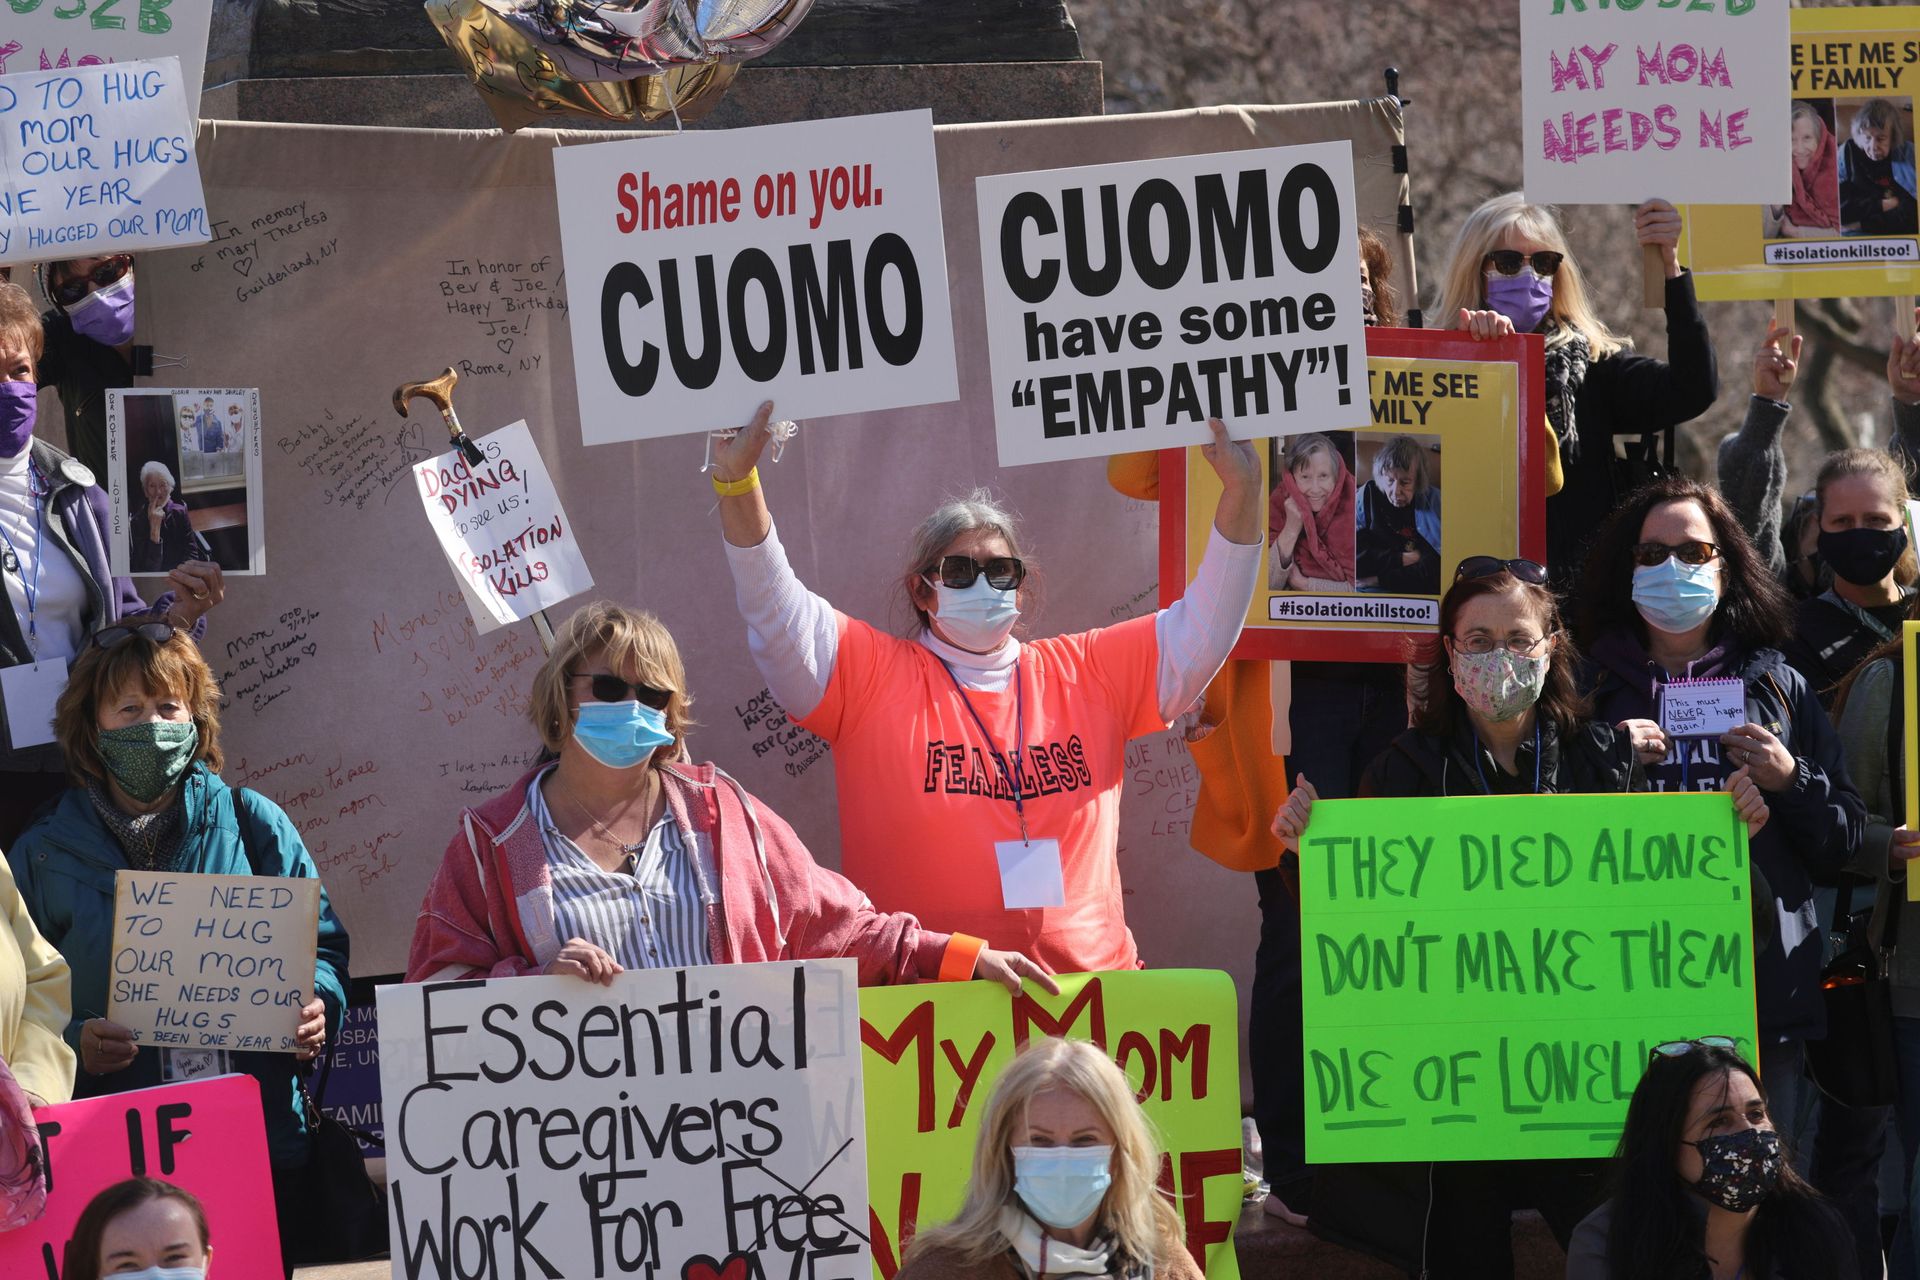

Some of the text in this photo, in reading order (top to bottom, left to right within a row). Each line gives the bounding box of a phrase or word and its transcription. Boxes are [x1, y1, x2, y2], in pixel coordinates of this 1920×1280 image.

[1550, 42, 1619, 93] MY
[1636, 41, 1733, 89] MOM
[1811, 43, 1853, 65] LET
[1860, 42, 1896, 64] ME
[35, 77, 83, 110] TO
[103, 71, 165, 104] HUG
[1810, 66, 1904, 91] FAMILY
[1543, 104, 1753, 164] NEEDS ME
[22, 137, 188, 175] OUR HUGS
[63, 178, 141, 210] YEAR
[616, 163, 883, 234] Shame on you.
[28, 223, 98, 249] HUGGED
[108, 215, 148, 238] OUR
[209, 201, 306, 243] In memory
[1000, 162, 1341, 304] CUOMO
[191, 256, 206, 272] of
[264, 211, 328, 242] Theresa
[1773, 243, 1911, 261] #isolationkillstoo!
[446, 255, 551, 276] In honor of
[439, 281, 479, 297] Bev
[446, 299, 491, 318] Happy
[600, 232, 924, 398] CUOMO
[1023, 292, 1337, 362] have some
[458, 355, 542, 378] Rome, NY
[1384, 370, 1424, 398] ME
[1432, 372, 1479, 399] SEE
[1370, 399, 1433, 426] MILY
[109, 414, 118, 462] MOTHER
[113, 479, 122, 535] LOUISE
[1279, 601, 1432, 619] #isolationkillstoo!
[1667, 697, 1721, 707] This must
[1668, 707, 1705, 720] NEVER
[1670, 718, 1706, 733] again!
[924, 734, 1092, 801] FEARLESS
[1309, 807, 1743, 901] THEY DIED ALONE!
[131, 881, 293, 909] WE NEED
[125, 915, 273, 944] TO HUG
[115, 948, 287, 981] OUR MOM
[1316, 918, 1743, 996] DON'T MAKE THEM
[114, 980, 305, 1008] SHE NEEDS OUR
[155, 1007, 237, 1030] HUGS
[422, 966, 807, 1083] Essential
[153, 1030, 190, 1045] BEEN
[236, 1035, 271, 1050] YEAR
[1310, 1046, 1394, 1114] DIE
[1413, 1050, 1482, 1108] OF
[125, 1102, 193, 1176] IF
[399, 1081, 783, 1209] Caregivers
[391, 1174, 563, 1280] Work
[722, 1158, 849, 1252] Free
